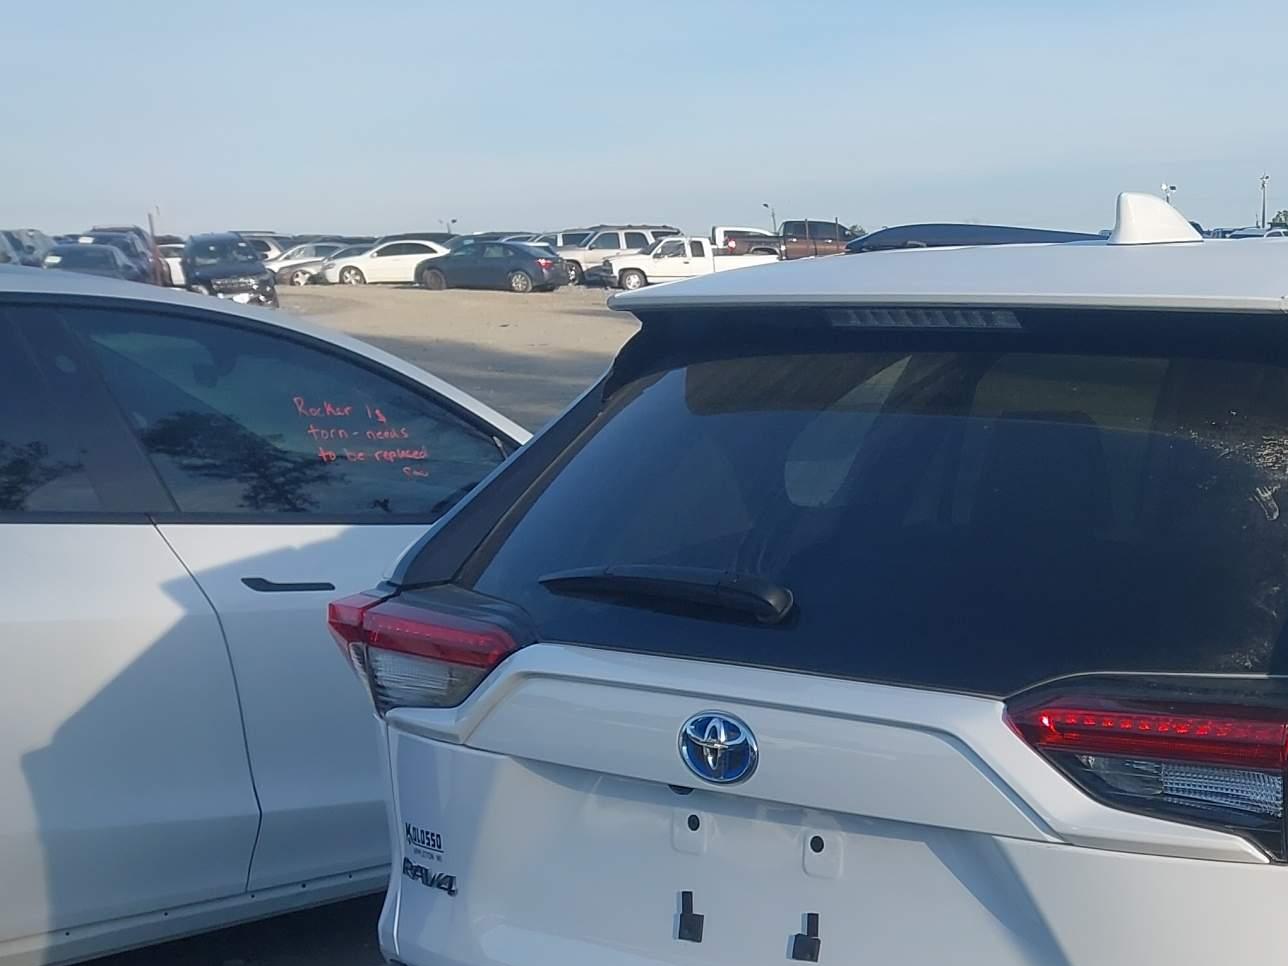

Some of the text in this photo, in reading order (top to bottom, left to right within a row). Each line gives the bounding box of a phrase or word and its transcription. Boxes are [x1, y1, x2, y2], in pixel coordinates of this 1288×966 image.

[318, 446, 336, 462] to
[343, 447, 366, 462] be
[405, 822, 443, 850] KOLOSSO
[403, 856, 457, 896] RAV4
